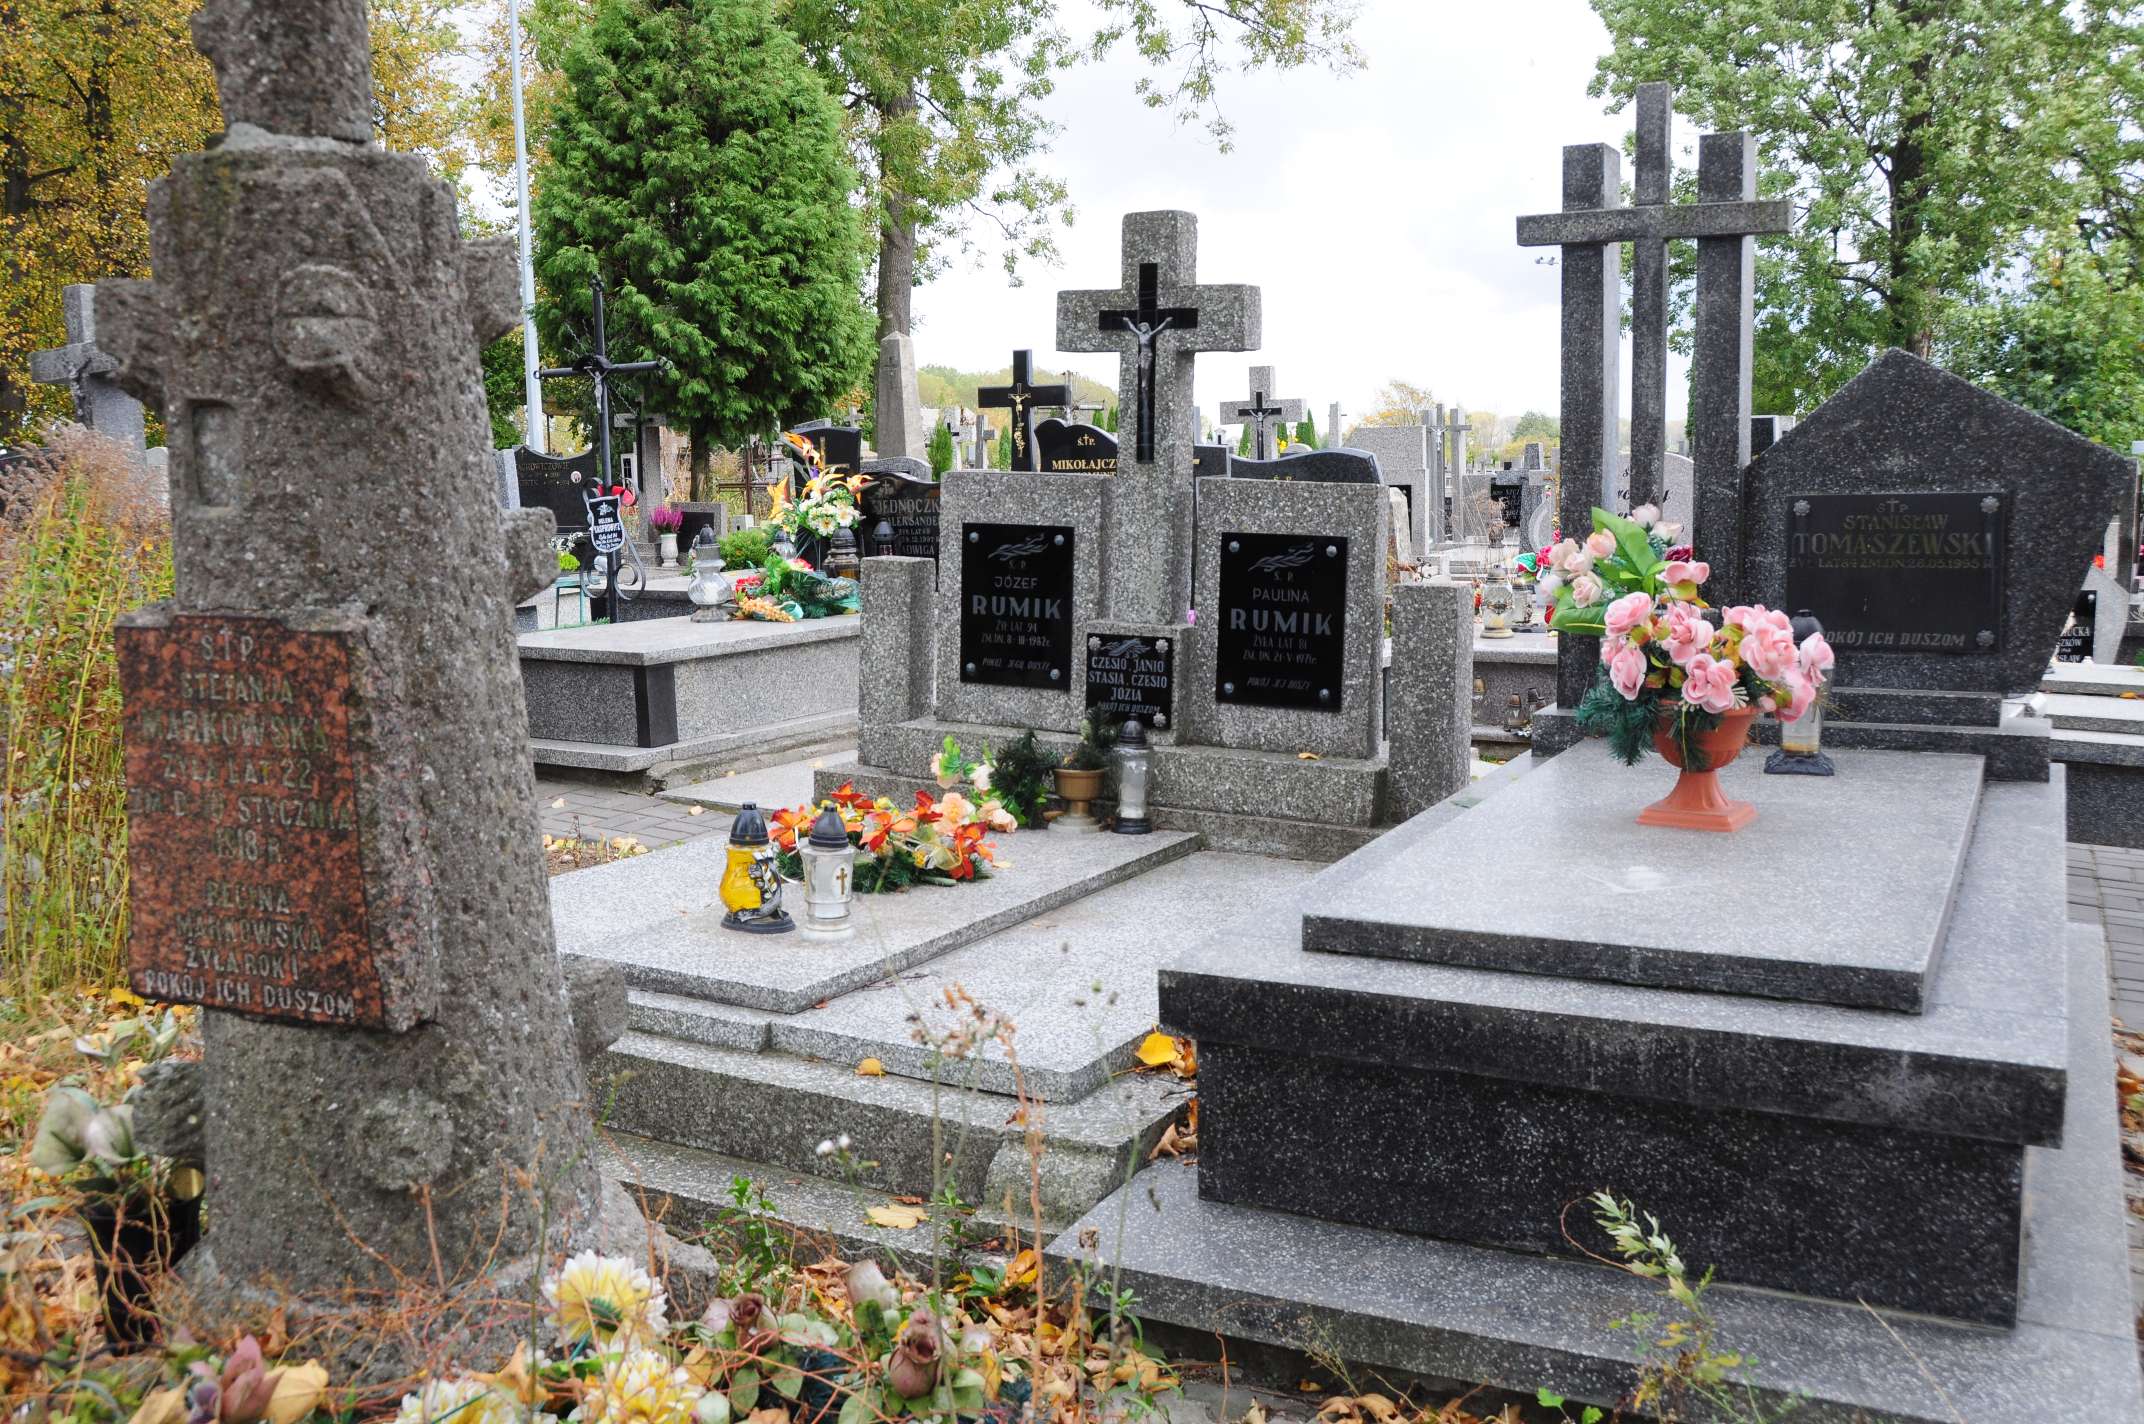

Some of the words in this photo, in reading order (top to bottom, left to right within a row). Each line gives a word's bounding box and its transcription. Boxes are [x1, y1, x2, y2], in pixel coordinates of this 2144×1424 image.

[1051, 458, 1119, 470] MIKOŁAJCZ
[879, 498, 940, 515] JEDNOCZK
[887, 516, 939, 528] LEKSANDE
[1843, 513, 1949, 530] STANISŁAW
[1793, 532, 1993, 555] TOMASZEWSKI
[993, 574, 1039, 590] JÓZEF
[1252, 586, 1310, 604] PAULINA
[971, 594, 1062, 620] RUMIK
[1230, 607, 1333, 636] RUMIK
[1822, 629, 1863, 647] OKÓJ
[1867, 631, 1895, 645] ICH
[1899, 632, 1966, 647] DUSZOM
[1133, 659, 1165, 674] JANIO
[1131, 673, 1168, 689] CZESIO
[139, 708, 330, 753] MARKOWSKA
[228, 758, 270, 787] LAT
[281, 759, 313, 790] 22
[237, 795, 353, 831] STYCZNIA
[205, 879, 291, 915] REGINA
[176, 910, 324, 954] MARKOWSKA
[186, 942, 240, 976] ŻYŁA
[243, 950, 286, 980] ROK
[143, 966, 207, 1000] POKÓJ
[214, 977, 252, 1007] ICH
[263, 983, 357, 1019] DUSZOM
